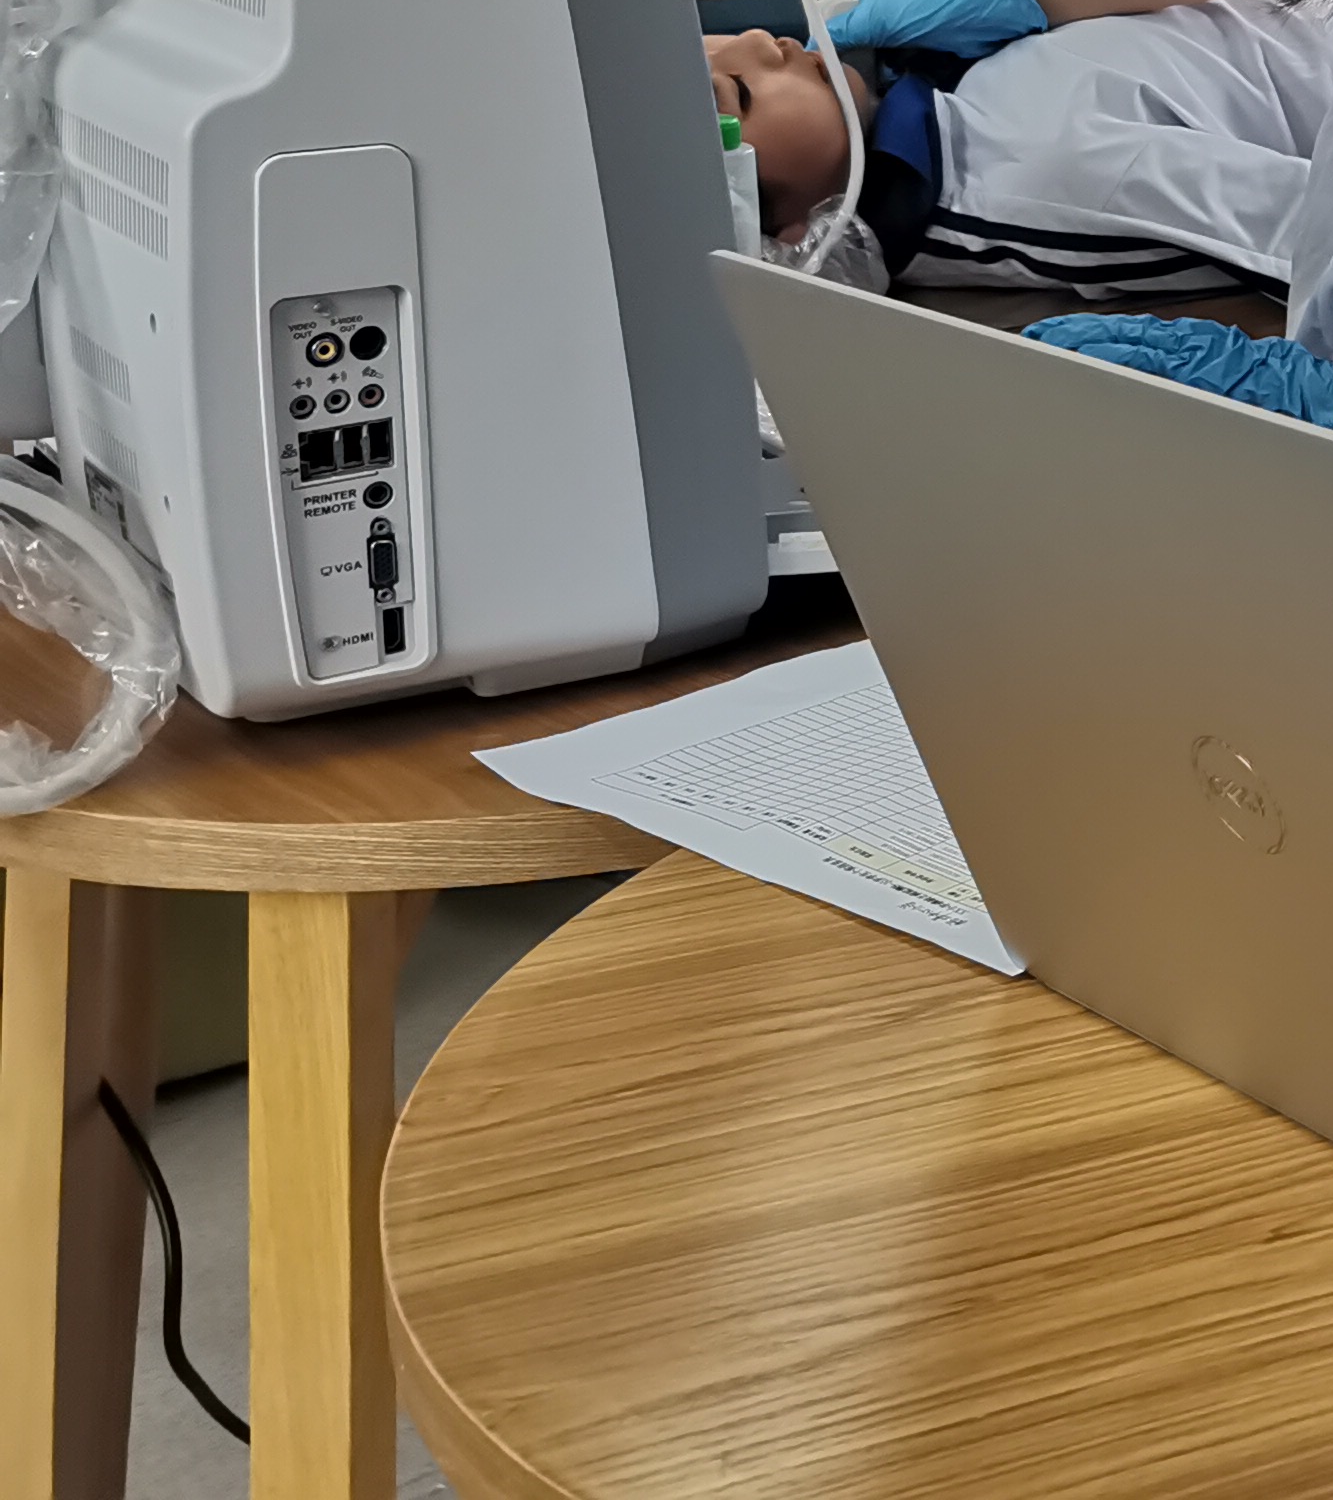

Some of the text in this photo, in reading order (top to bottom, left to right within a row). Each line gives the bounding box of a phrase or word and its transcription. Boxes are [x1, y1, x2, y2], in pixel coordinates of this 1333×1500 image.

[288, 321, 317, 332] VIDEO
[340, 325, 357, 333] OUT
[293, 331, 312, 340] OUT
[303, 488, 357, 507] PRINTER
[303, 500, 356, 519] REMOTE
[334, 560, 363, 573] VGA
[342, 631, 374, 646] HDMI
